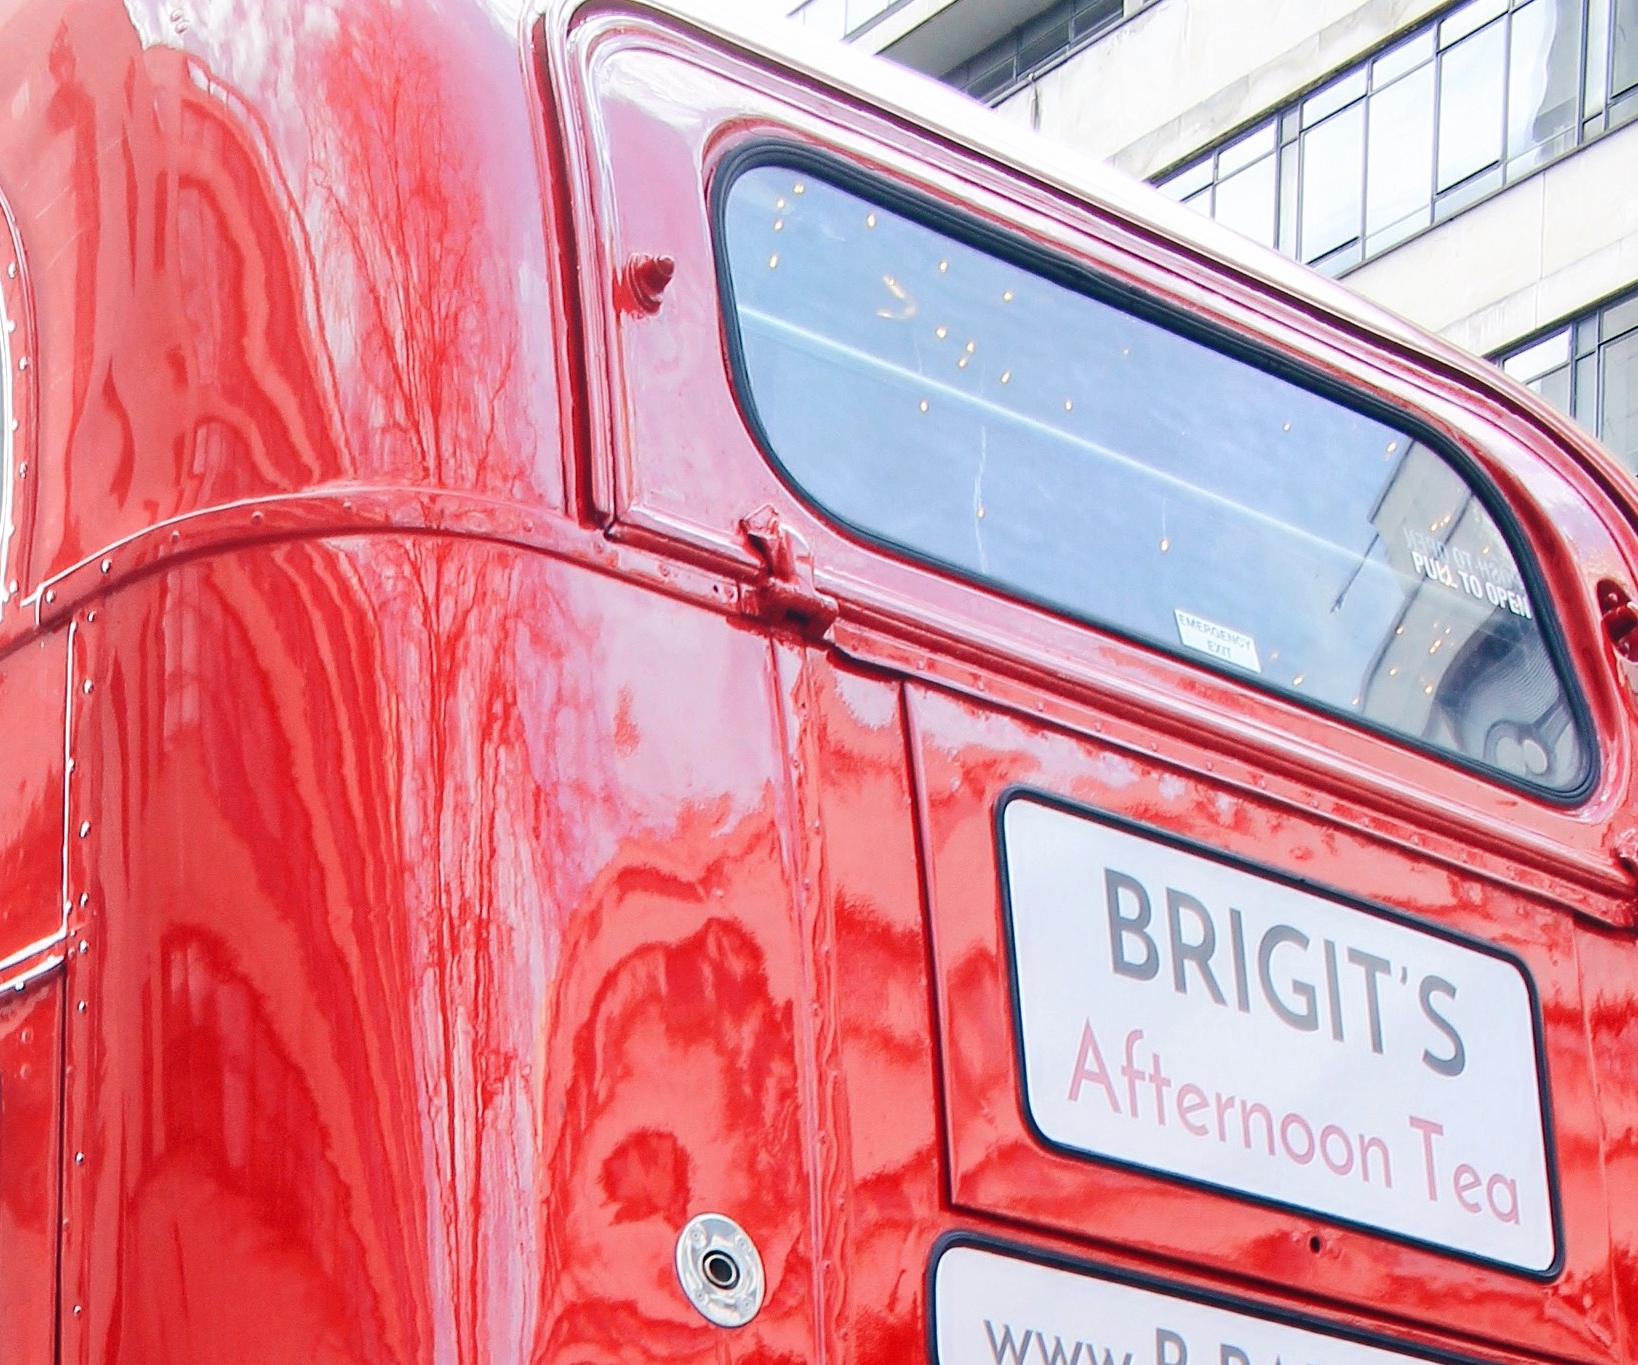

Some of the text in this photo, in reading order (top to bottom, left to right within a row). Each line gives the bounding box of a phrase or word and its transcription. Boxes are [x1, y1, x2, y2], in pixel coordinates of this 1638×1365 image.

[1411, 550, 1533, 620] PULL TO OPEN
[1178, 613, 1251, 651] EMERGENCY
[1207, 640, 1232, 659] EXIT
[1102, 866, 1468, 1079] BRIGIT'S
[1067, 1017, 1522, 1227] Afternoon Tea
